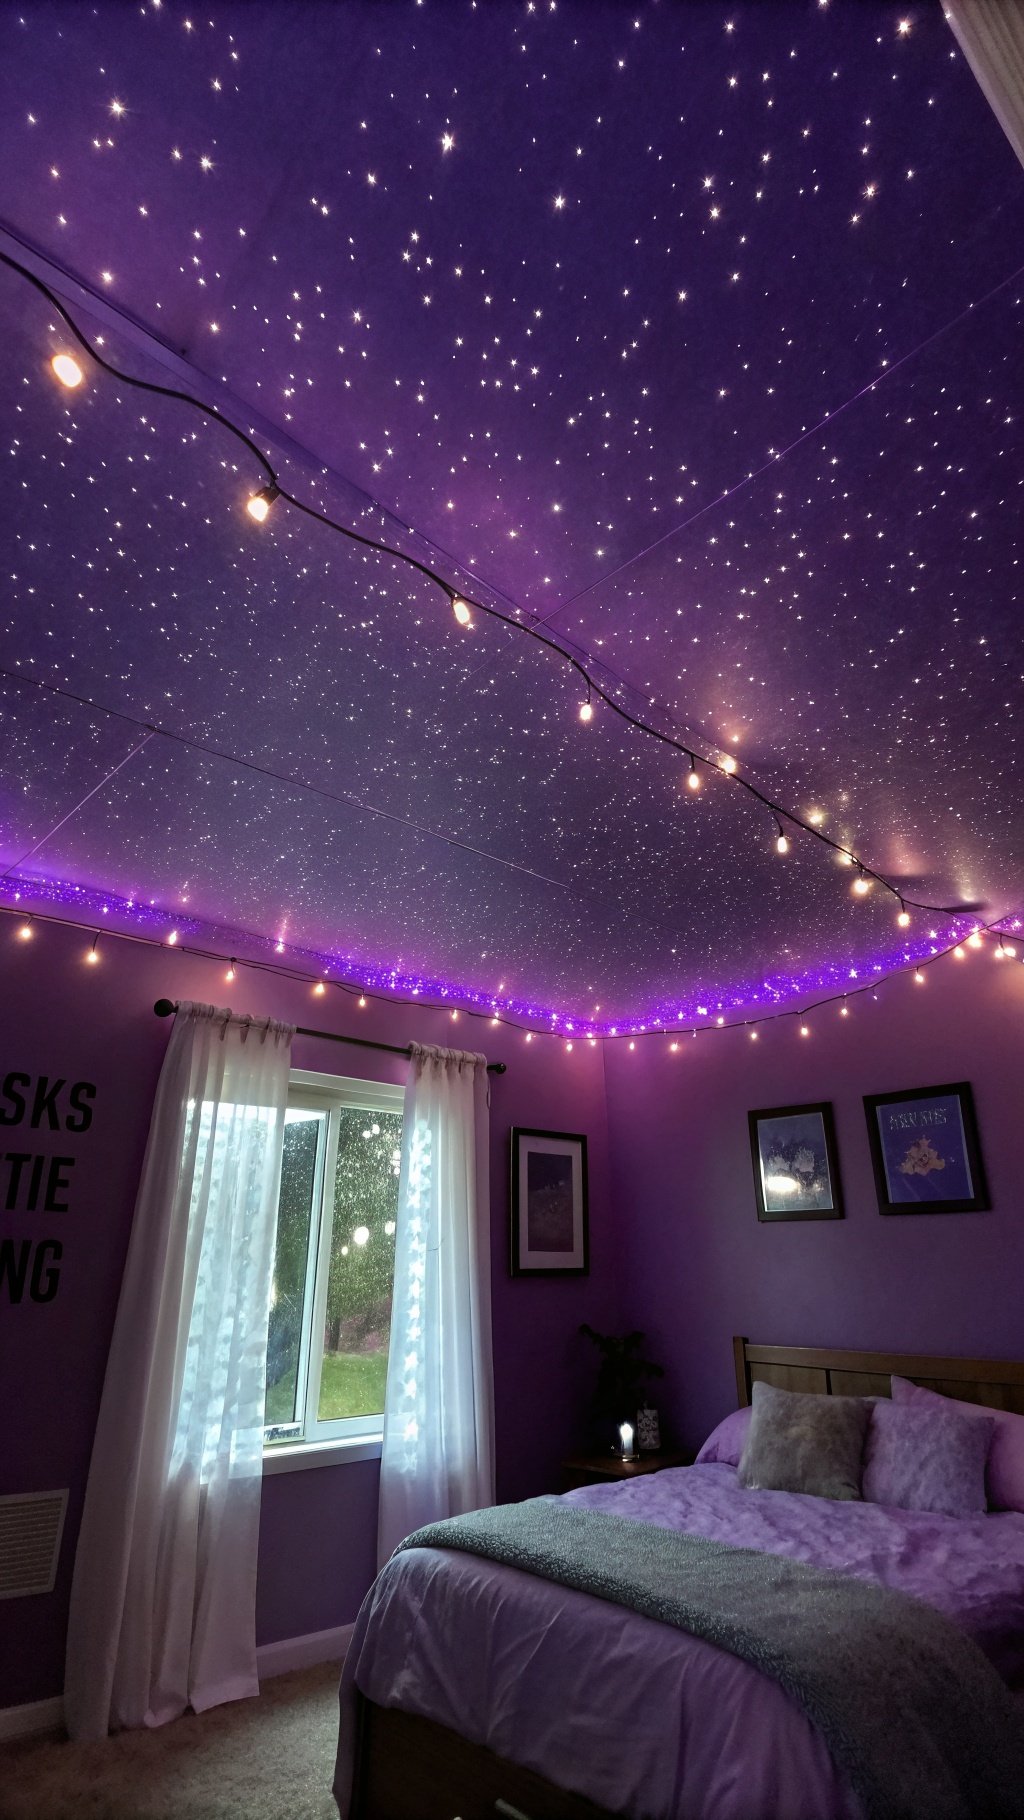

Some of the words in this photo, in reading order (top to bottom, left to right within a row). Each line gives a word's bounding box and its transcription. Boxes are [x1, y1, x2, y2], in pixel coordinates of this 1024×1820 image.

[0, 1072, 96, 1132] SKS
[0, 1153, 75, 1212] TIE
[0, 1239, 63, 1304] NG
